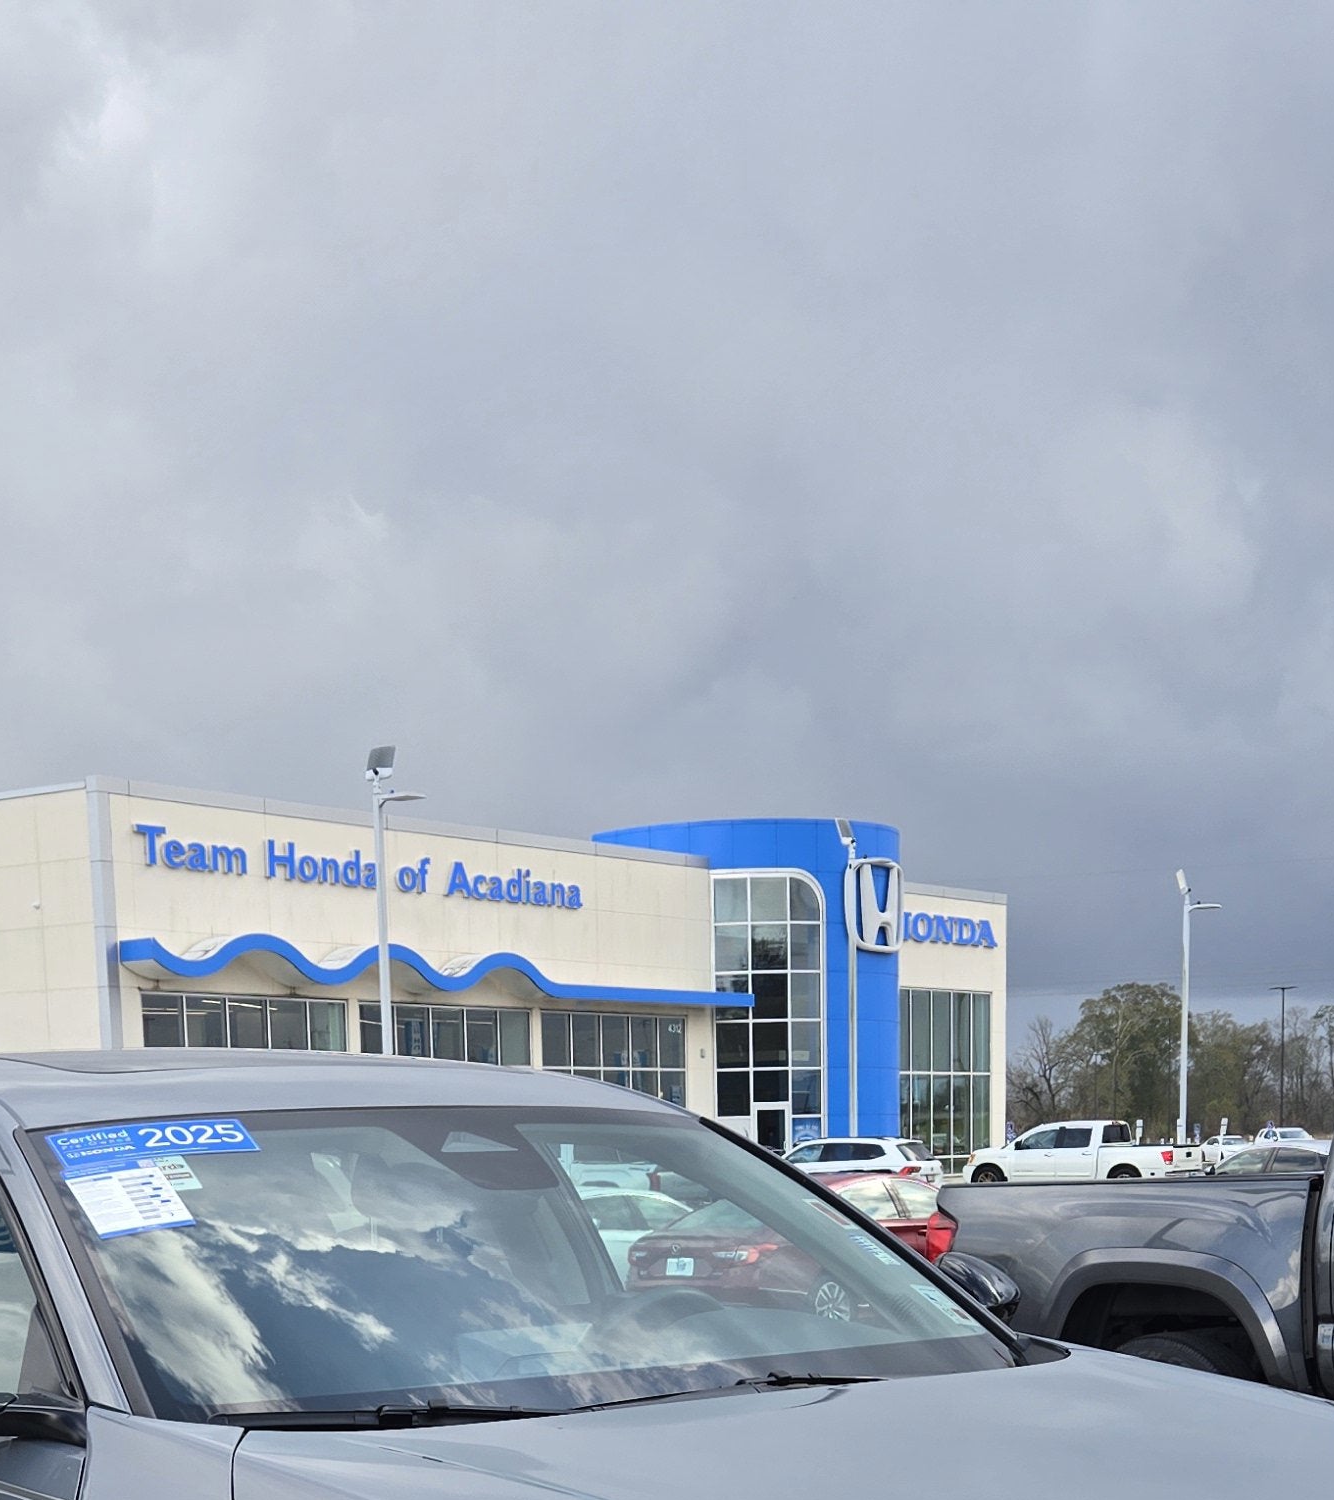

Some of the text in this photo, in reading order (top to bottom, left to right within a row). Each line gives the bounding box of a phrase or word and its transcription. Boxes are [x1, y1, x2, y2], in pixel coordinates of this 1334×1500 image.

[133, 823, 584, 910] Team Honda of Acadiana
[56, 1129, 129, 1146] Certified
[137, 1124, 245, 1148] 2025
